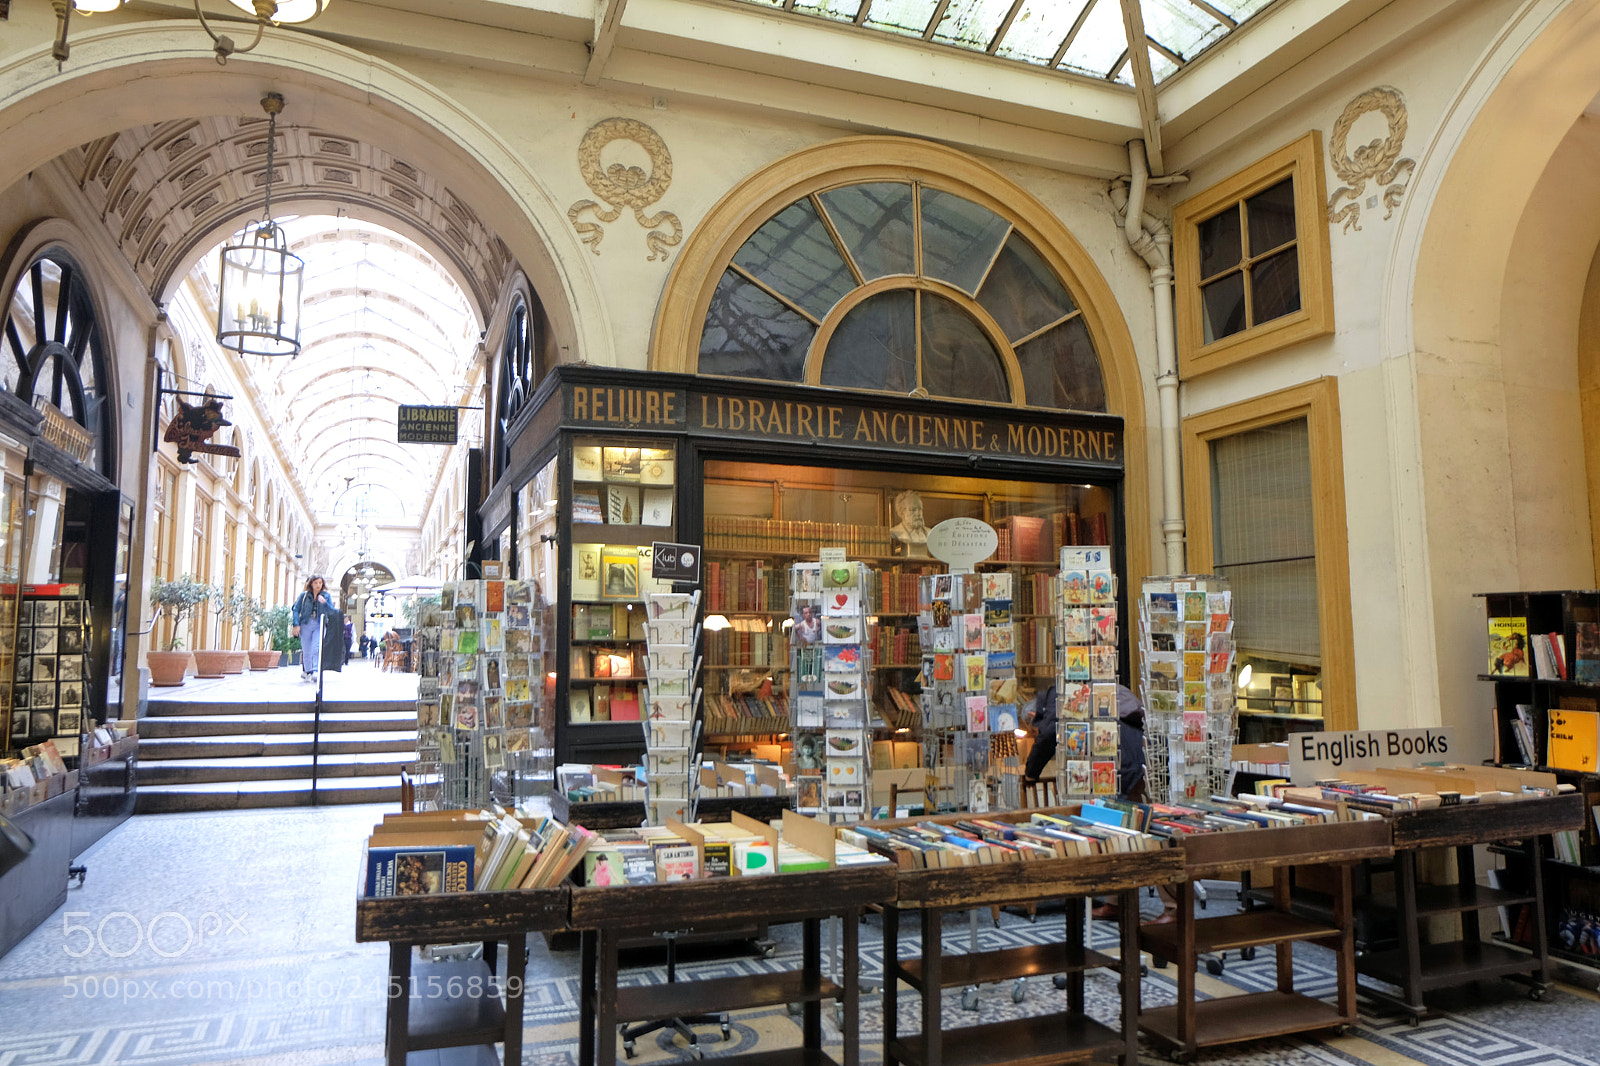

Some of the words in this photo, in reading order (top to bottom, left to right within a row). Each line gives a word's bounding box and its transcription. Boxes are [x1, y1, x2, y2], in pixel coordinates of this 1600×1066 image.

[399, 407, 456, 422] LIBRAIRIE
[573, 386, 676, 425] RELIURE
[399, 432, 456, 442] MODERNE
[400, 422, 455, 432] ANCIENNE
[701, 395, 844, 438] LIBRAIRIE
[853, 409, 985, 451] ANCIENNE
[990, 435, 1000, 452] &
[1007, 423, 1115, 461] MODERNE
[654, 547, 676, 568] Klub
[1301, 734, 1380, 766] English
[1387, 730, 1448, 756] Books
